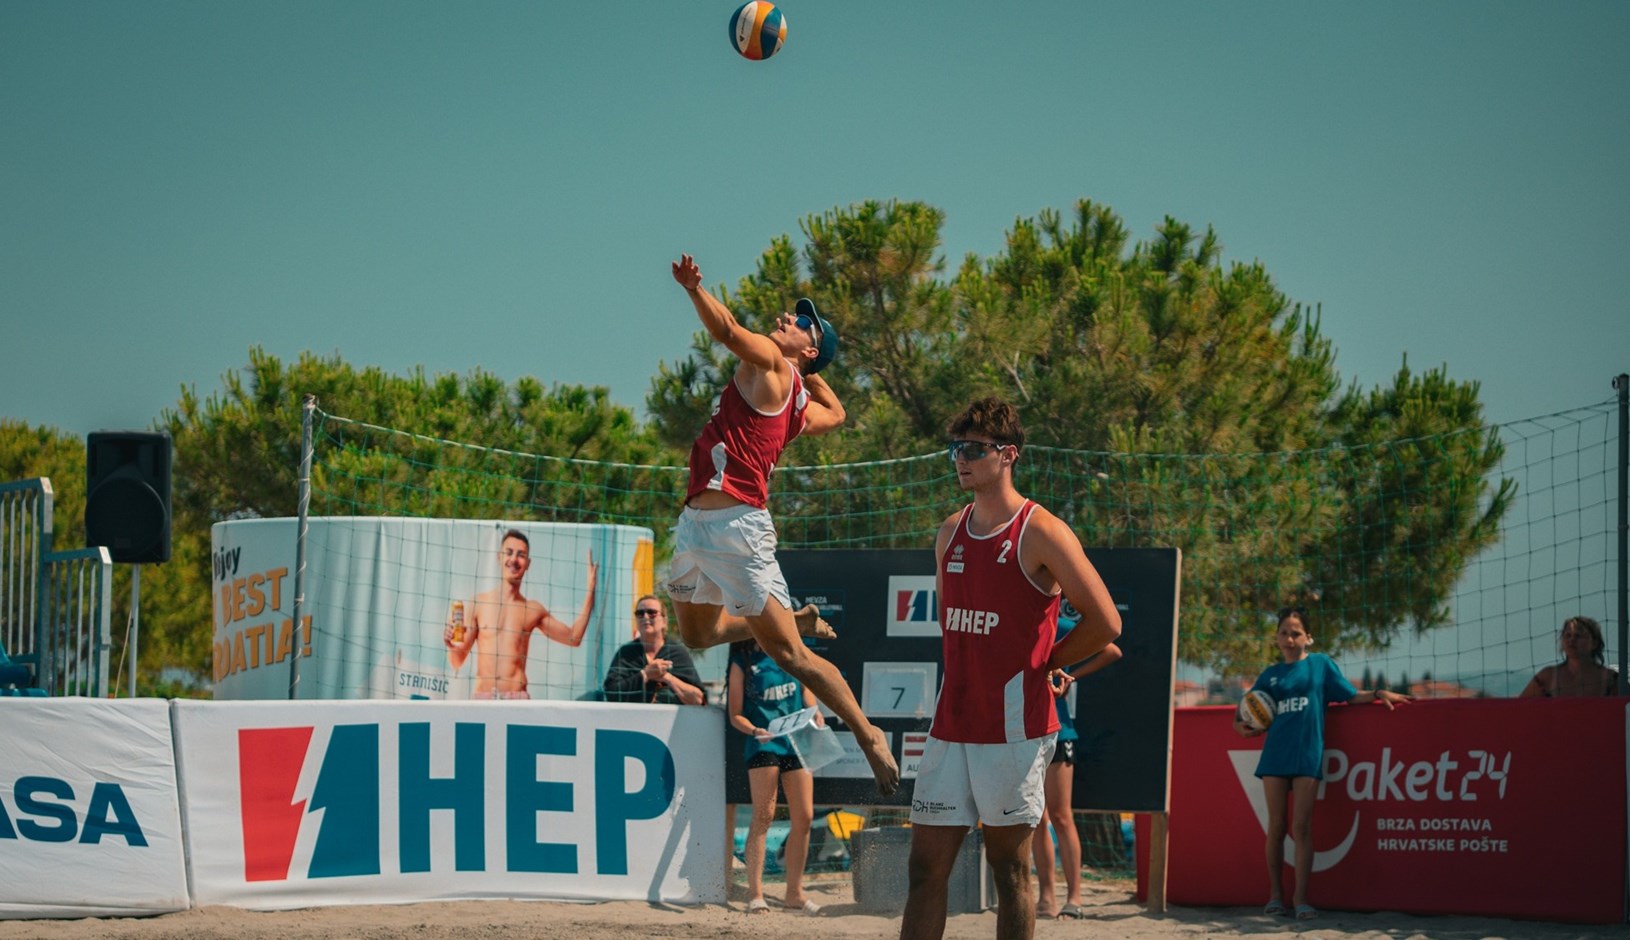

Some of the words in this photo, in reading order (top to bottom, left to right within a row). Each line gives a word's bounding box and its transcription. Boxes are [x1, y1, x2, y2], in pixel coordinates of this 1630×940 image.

[996, 539, 1013, 564] 2
[221, 566, 289, 628] BEST
[960, 609, 1000, 635] HEP
[891, 687, 905, 710] 7
[0, 775, 149, 847] SA
[398, 721, 676, 876] HEP
[1376, 818, 1416, 831] BRZA
[1420, 818, 1492, 831] DOSTAVA
[1377, 838, 1455, 851] HRVATSKE
[1460, 835, 1509, 852] POŠTE
